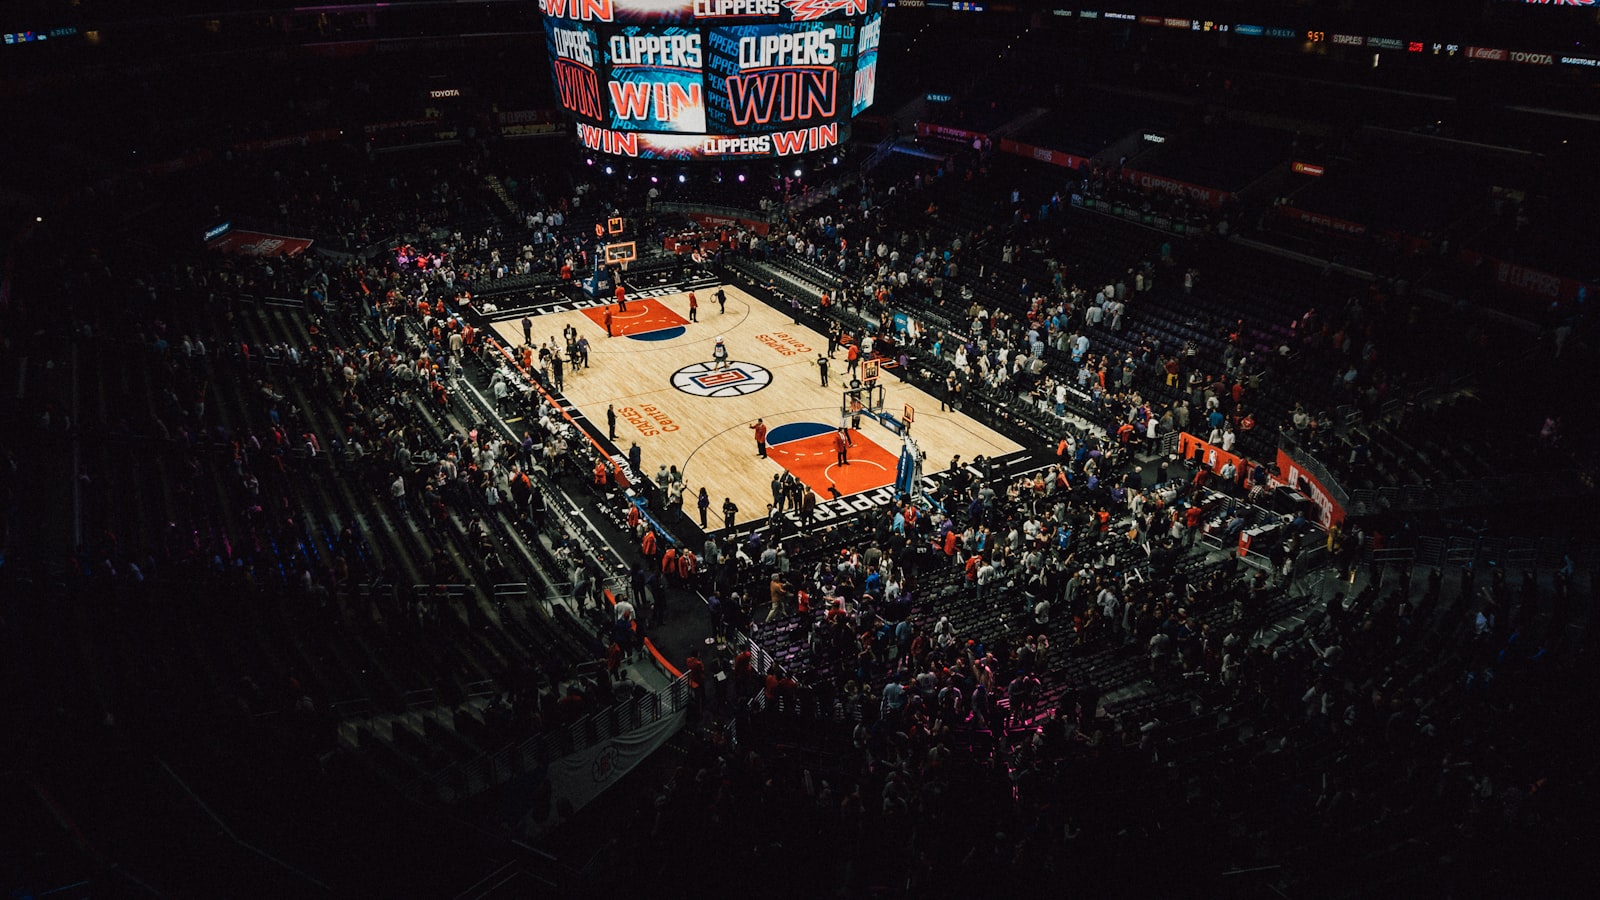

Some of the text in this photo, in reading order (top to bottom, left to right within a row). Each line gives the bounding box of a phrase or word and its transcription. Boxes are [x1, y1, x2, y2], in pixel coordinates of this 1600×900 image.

[694, 0, 780, 16] CLIPPERS
[1272, 28, 1296, 37] DELTA
[1333, 34, 1363, 45] STAPLES
[553, 27, 593, 67] CLIPPERS
[610, 33, 703, 68] CLIPPERS
[739, 28, 836, 69] CLIPPERS
[1510, 51, 1553, 65] TOYOTA
[430, 89, 460, 98] TOYOTA
[554, 60, 604, 122] WIN
[608, 81, 703, 121] WIN
[725, 65, 838, 126] WIN
[507, 110, 537, 122] CLIPPERS
[583, 123, 638, 157] WIN
[704, 135, 771, 153] CLIPPERS
[772, 122, 838, 156] WIN
[1143, 132, 1165, 144] verizon
[1511, 266, 1561, 297] CLIPPERS
[537, 304, 570, 315] LA
[755, 334, 797, 357] STAPLES
[772, 331, 812, 354] Center
[618, 407, 660, 437] STAPLES
[640, 403, 680, 432] Center
